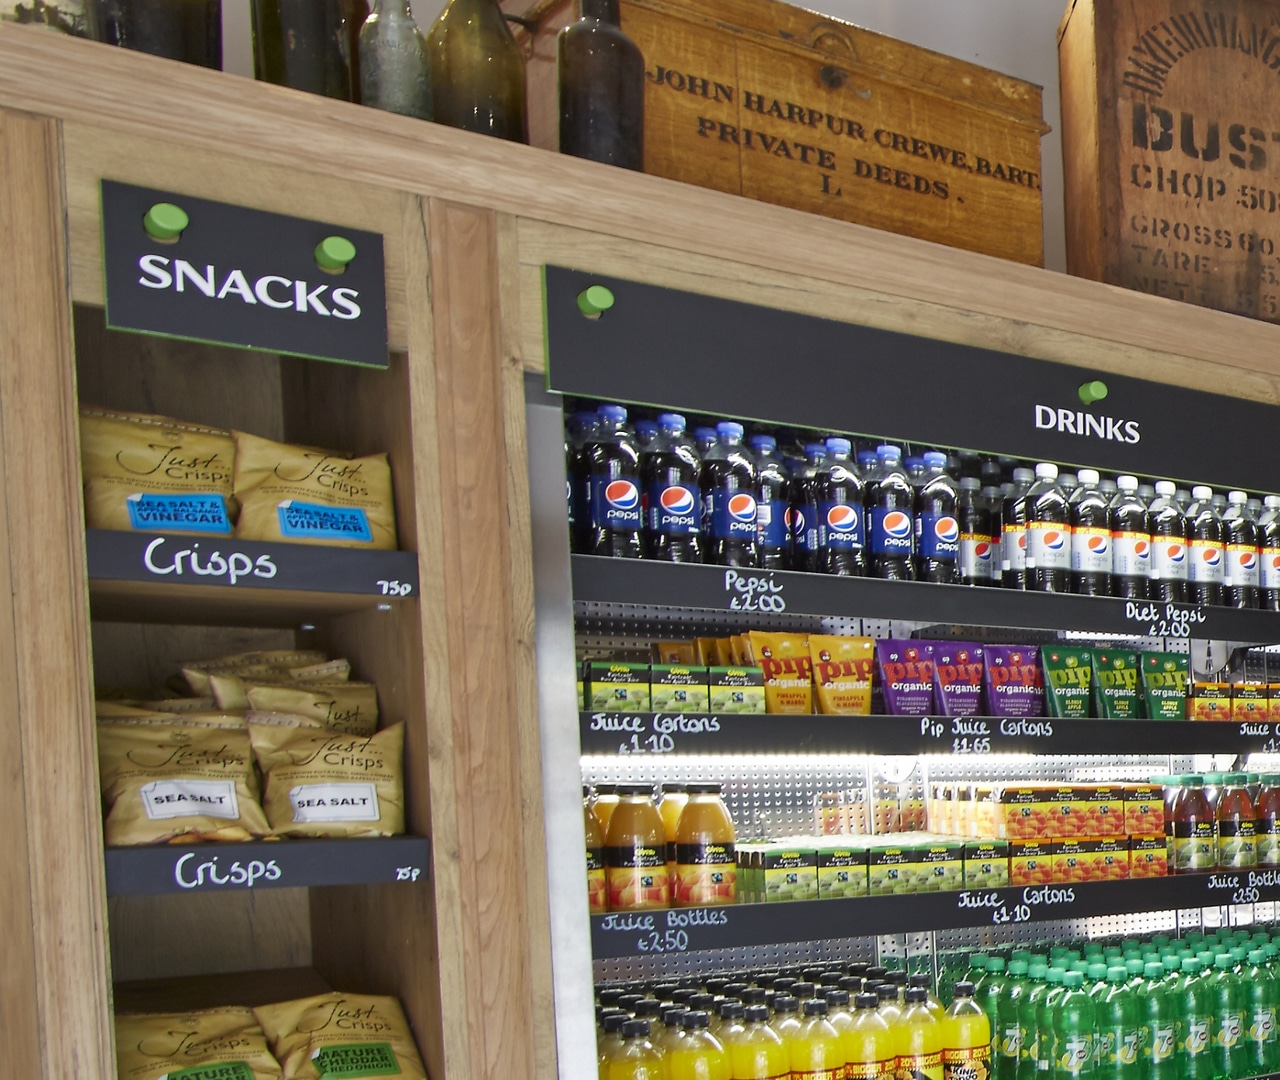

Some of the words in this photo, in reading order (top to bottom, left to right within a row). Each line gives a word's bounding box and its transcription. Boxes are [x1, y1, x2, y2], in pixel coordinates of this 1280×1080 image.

[645, 64, 734, 103] JOHN
[743, 90, 868, 143] HARPUR
[696, 116, 837, 171] PRIVATE
[1130, 163, 1227, 203] CHOP
[138, 253, 362, 321] SNACKS
[1033, 404, 1141, 447] DRINKS
[316, 474, 370, 497] Crisps
[137, 511, 224, 526] VINEGAR
[287, 518, 364, 534] VINEGAR
[606, 508, 639, 522] pepsi
[661, 514, 695, 528] pepsi
[143, 537, 280, 586] Crisps
[375, 577, 413, 597] 75p
[724, 569, 784, 596] Pepsi
[1125, 601, 1160, 621] Diet
[1165, 603, 1207, 624] Pepsi
[815, 657, 874, 686] pip
[768, 678, 812, 689] organic
[824, 680, 871, 692] organic
[590, 713, 646, 733] Juice
[653, 713, 722, 734] Cartons
[920, 717, 945, 739] Pip
[951, 717, 992, 735] Juice
[1000, 719, 1054, 738] Cartons
[1239, 722, 1271, 736] Juice
[174, 851, 283, 890] Crisps
[1207, 873, 1240, 892] Juice
[957, 890, 1006, 910] Juice
[1023, 886, 1076, 906] Cartons
[600, 913, 656, 932] Juice
[666, 908, 729, 930] Bottles
